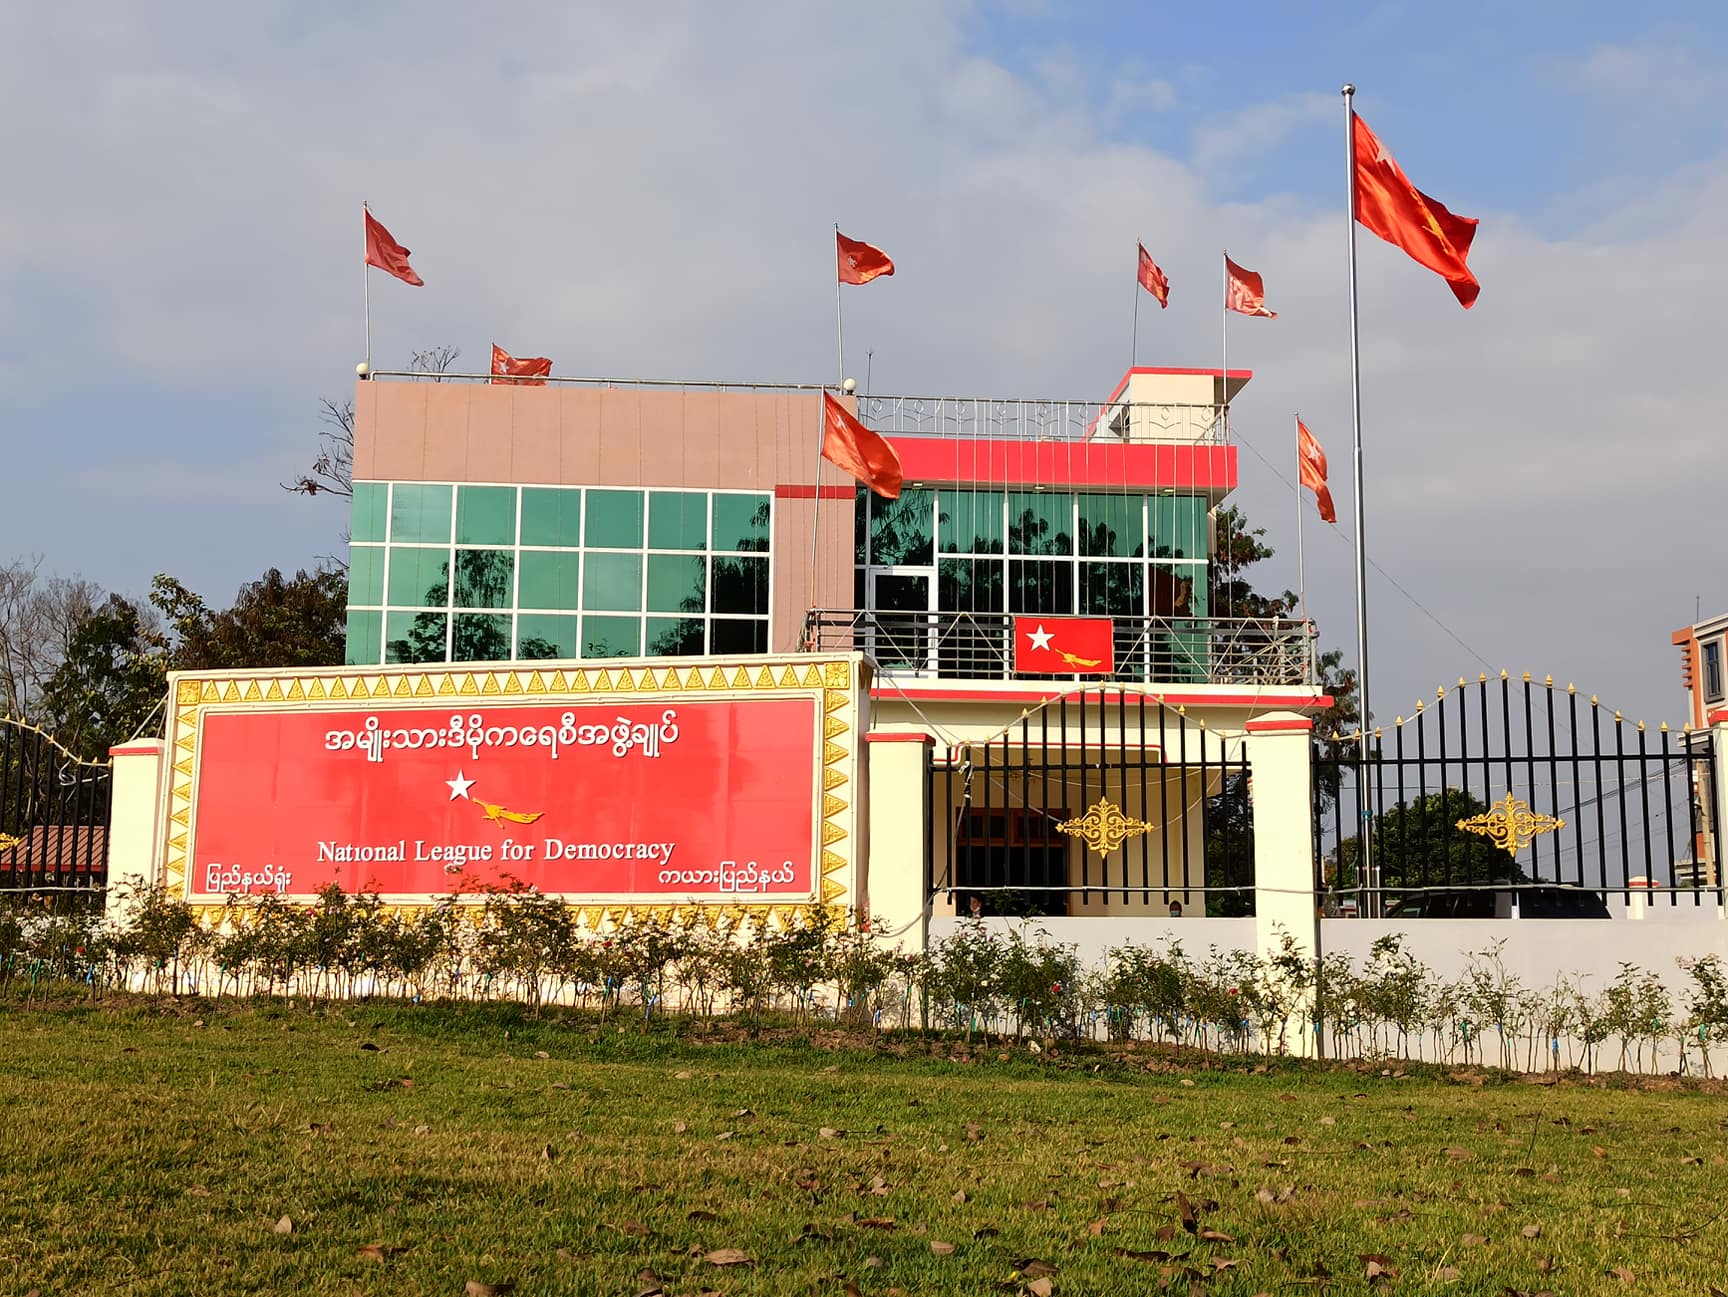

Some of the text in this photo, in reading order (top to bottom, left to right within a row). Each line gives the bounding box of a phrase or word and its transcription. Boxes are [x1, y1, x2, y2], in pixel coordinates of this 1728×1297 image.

[316, 838, 676, 872] National League for Democracy
[658, 860, 795, 893] ကယားပြည်နယ်
